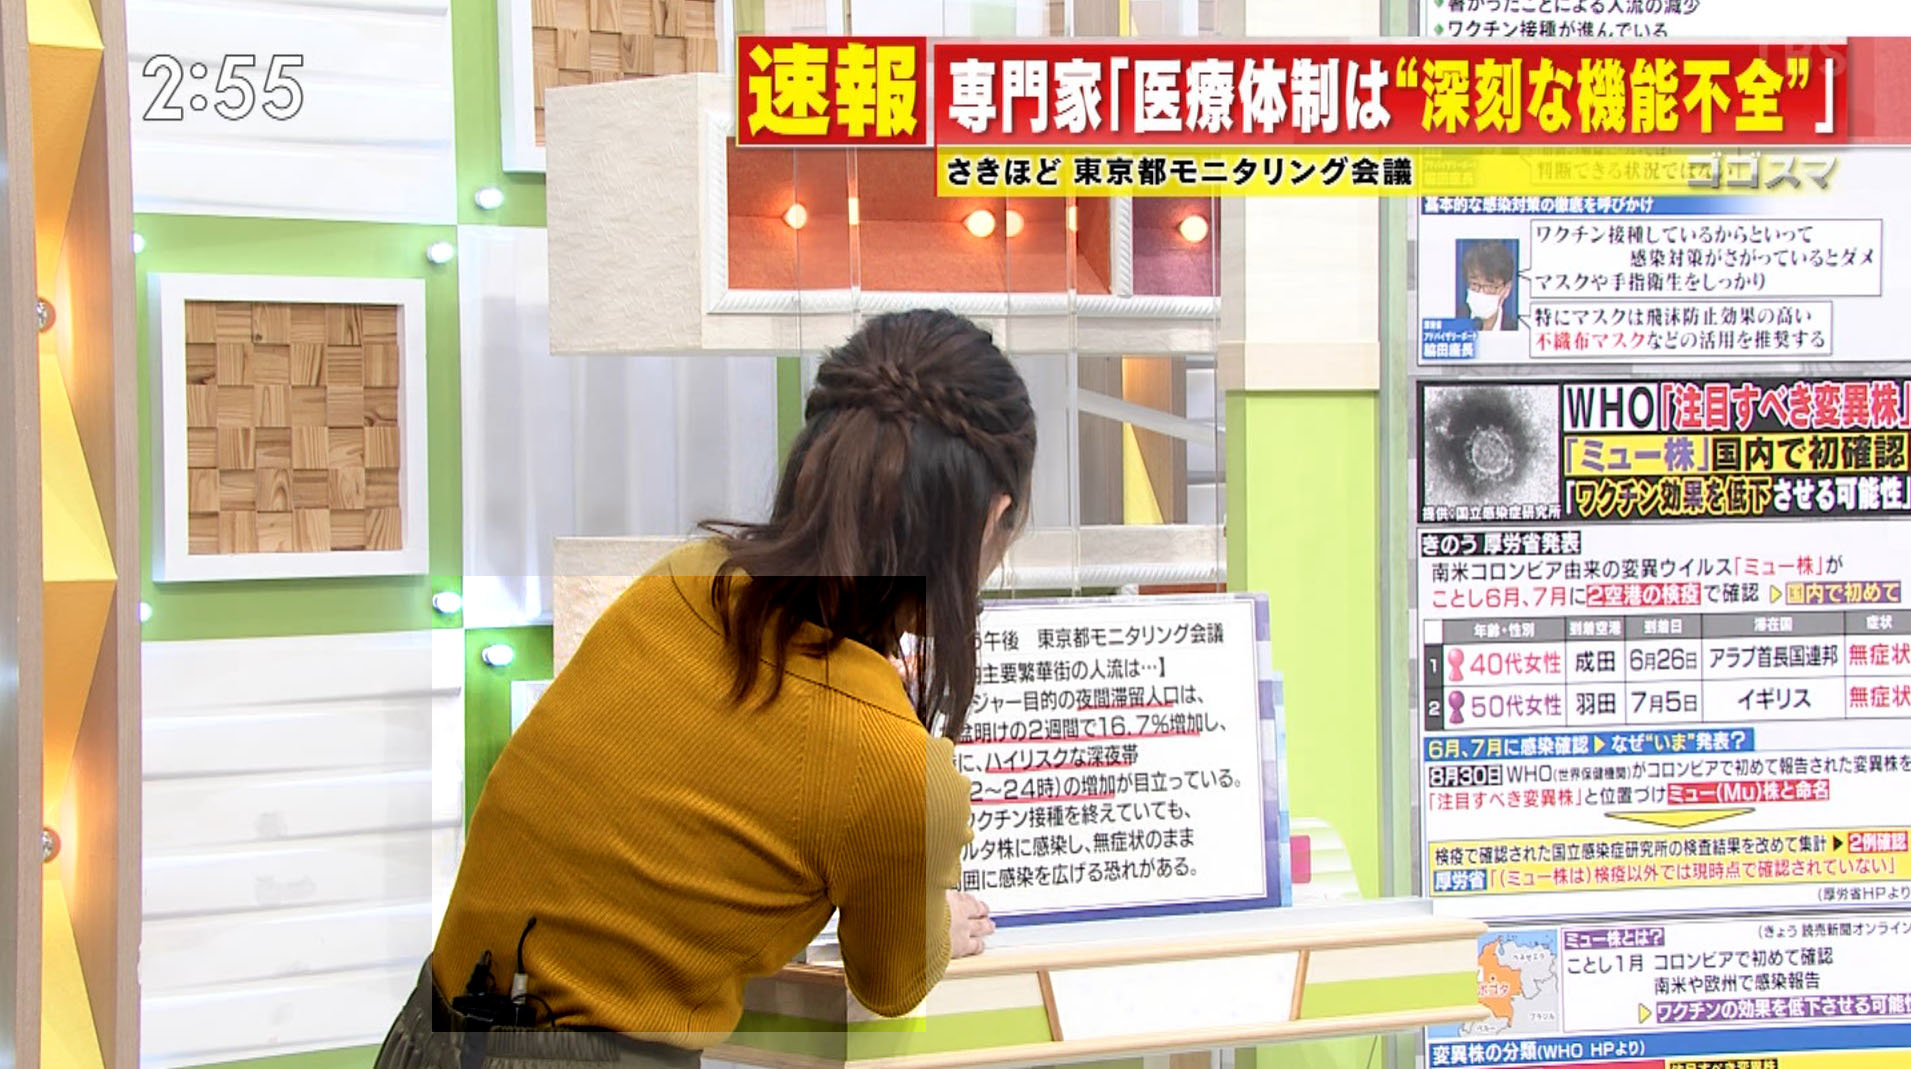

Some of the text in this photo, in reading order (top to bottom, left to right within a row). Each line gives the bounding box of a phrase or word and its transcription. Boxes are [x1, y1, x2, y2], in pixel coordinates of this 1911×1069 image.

[1536, 225, 1814, 244] ワクチン接種しているからといって
[1630, 247, 1875, 268] 感染対策がさがっているとダメ
[1535, 272, 1766, 292] マスクや手指衛生をしっかり
[1535, 306, 1812, 327] 特にマスクは飛沫防止効果の高い
[1536, 330, 1826, 351] 不織布マスクなどの活用を推奨する
[1566, 435, 1905, 473] 「ミュー株」国内で初確認
[1422, 532, 1581, 555] きのう 厚労省発表
[1432, 554, 1843, 583] 南米コロンビア由来の変異ウイルス「ミュー株」が
[1786, 582, 1900, 604] 国内で初めて
[1866, 614, 1893, 630] 症状
[1037, 622, 1225, 650] 東京都モニタリング会議
[1429, 643, 1911, 675] 1 40代女性 成田 6月26日 アラブ首長国連邦 無症状
[1429, 686, 1911, 718] 2 50代女性 羽田 7月5日 イギリス 無症状
[1428, 735, 1589, 759] 6月、7月に感染確認
[1430, 766, 1502, 787] 8月30日
[1849, 832, 1908, 851] 2例確認
[1435, 871, 1485, 890] 厚労省
[1818, 886, 1911, 902] (厚労省HPより
[1568, 946, 1833, 975] ことし1月 コロンビアで初めて確認
[1655, 971, 1820, 995] 南米や欧州で感染報告
[1591, 1041, 1645, 1058] HPより)
